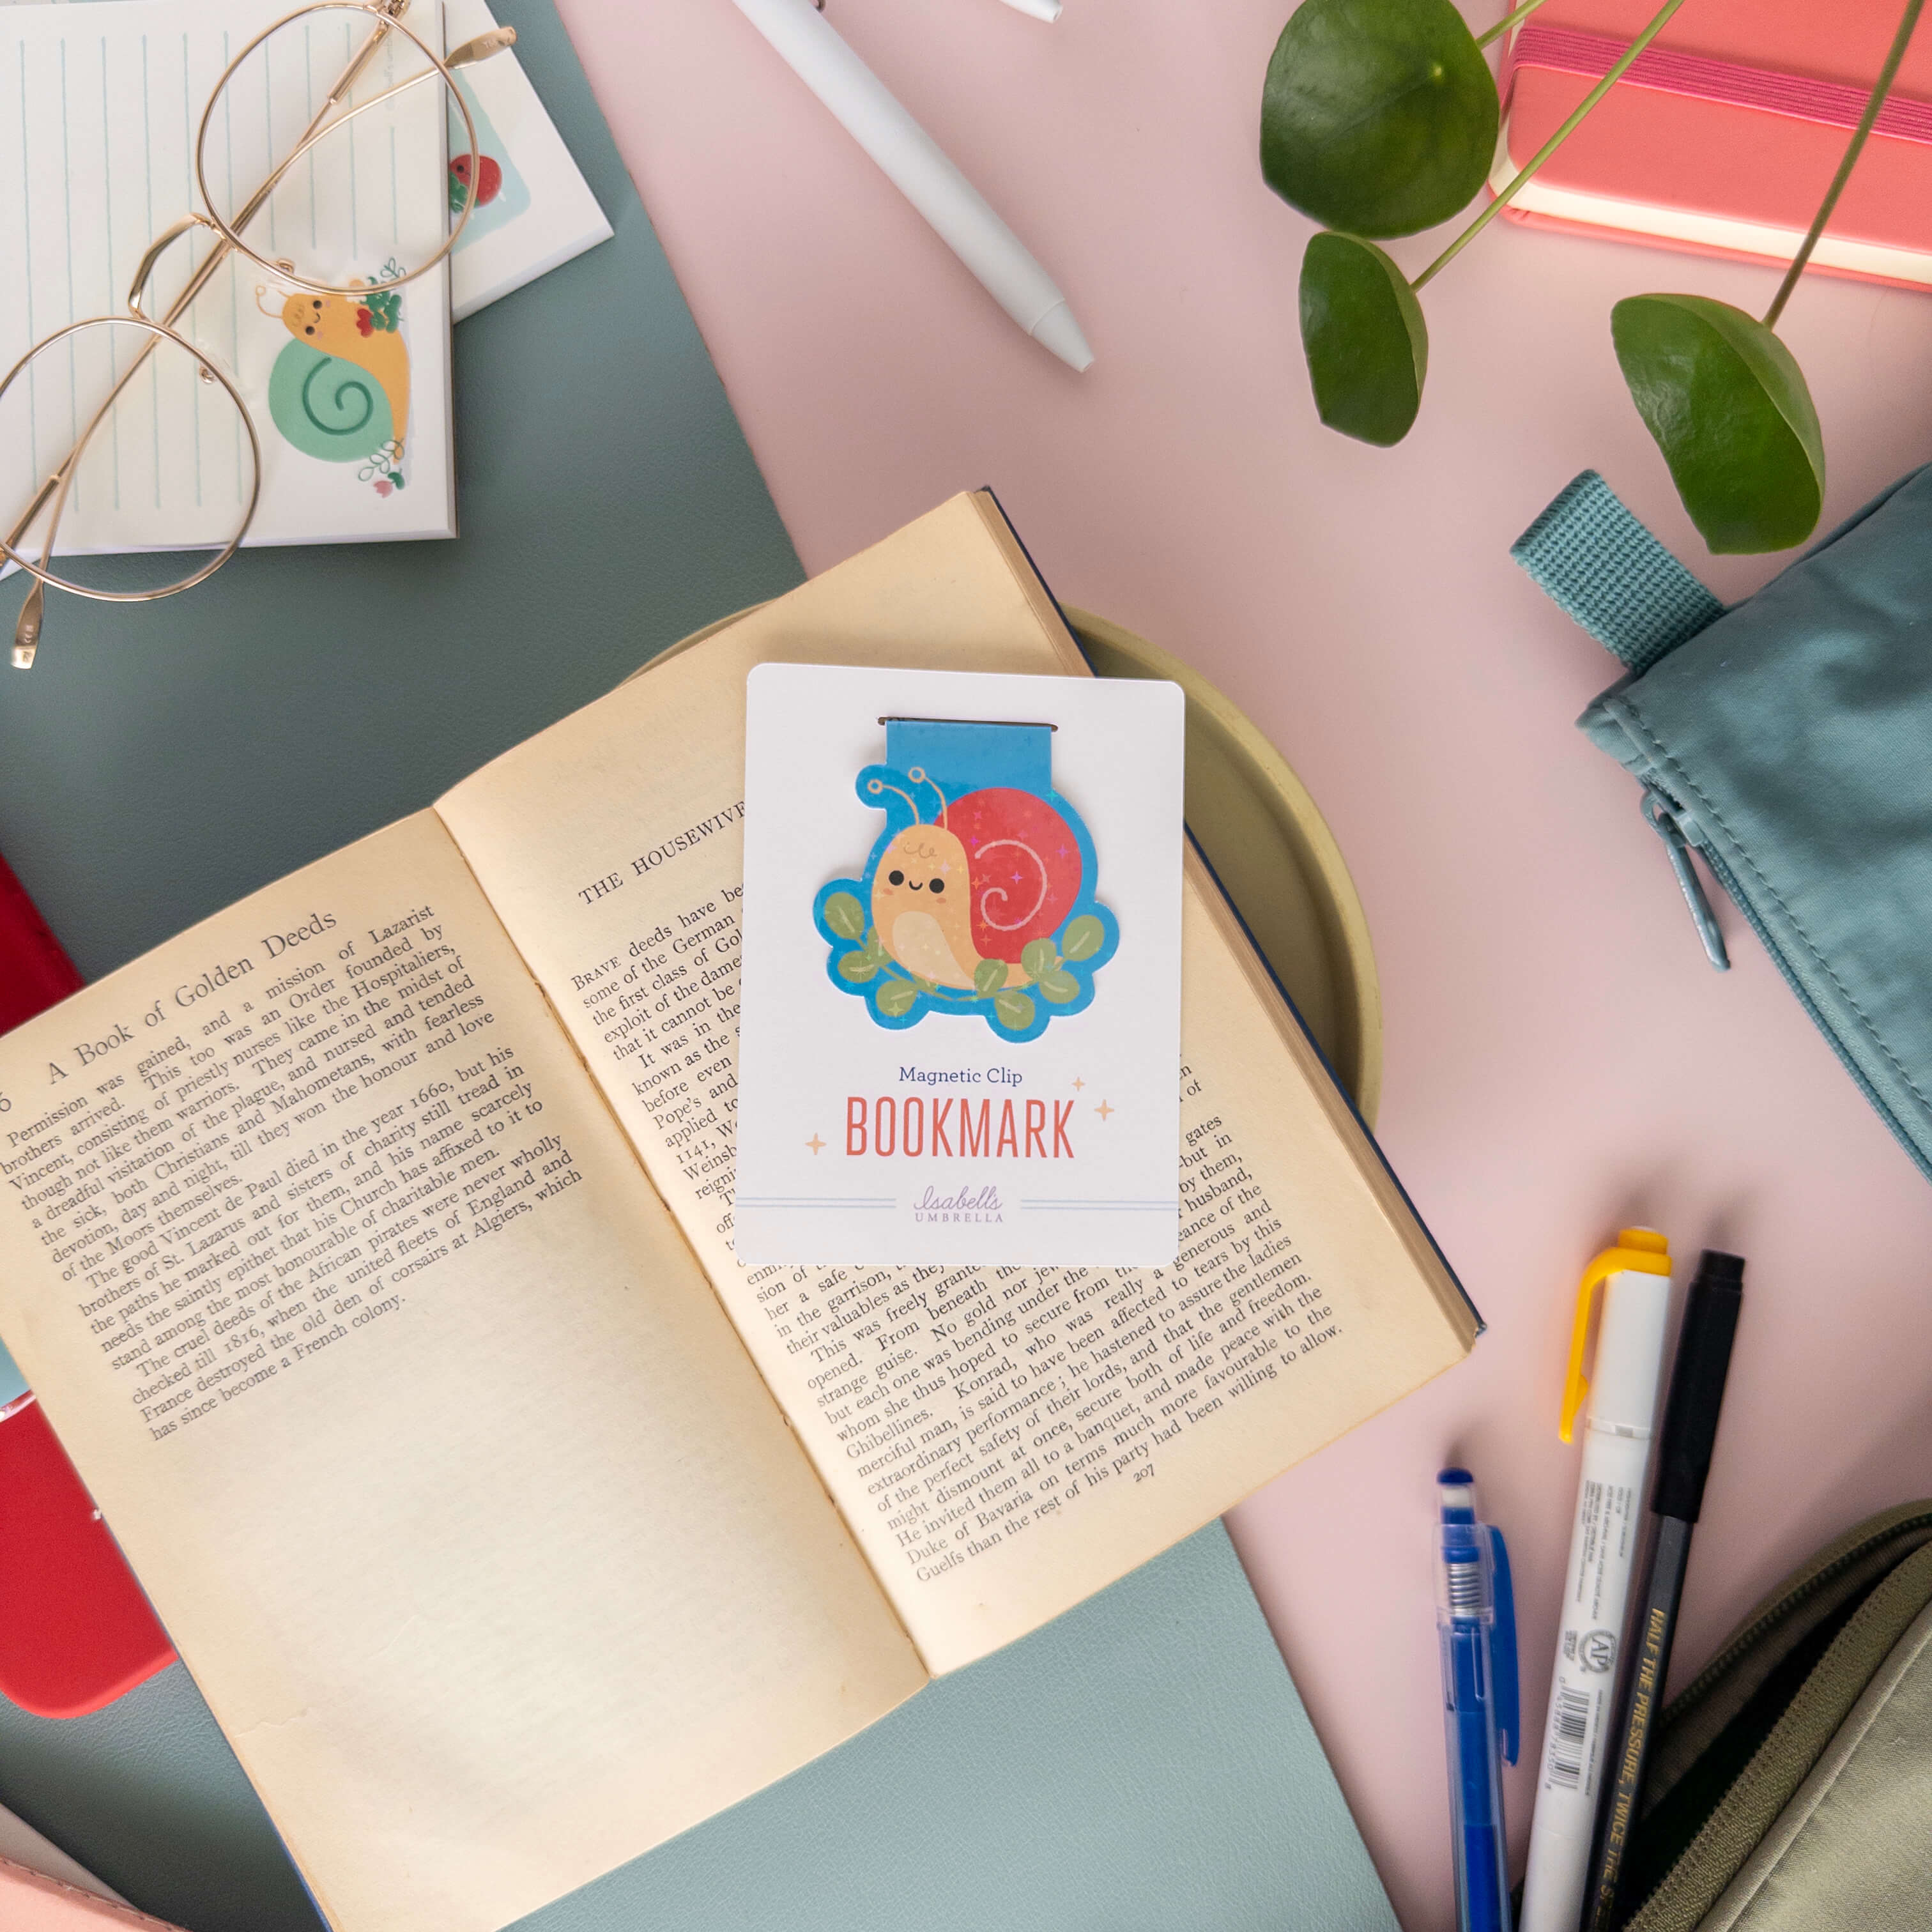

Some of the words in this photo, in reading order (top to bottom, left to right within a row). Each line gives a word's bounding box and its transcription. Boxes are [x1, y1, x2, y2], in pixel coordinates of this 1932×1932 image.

[577, 871, 624, 905] THE
[582, 981, 621, 1009] some
[622, 963, 640, 985] of
[640, 953, 668, 974] the
[671, 914, 737, 955] German
[628, 926, 673, 958] deeds
[676, 901, 717, 930] have
[48, 1061, 70, 1085] A
[72, 1023, 136, 1067] Book
[144, 999, 167, 1028] of
[174, 958, 256, 1008] Golden
[259, 912, 337, 960] Deeds
[592, 1006, 617, 1027] the
[618, 985, 650, 1011] first
[651, 964, 689, 992] class
[693, 946, 710, 967] of
[603, 1007, 653, 1044] exploit
[654, 992, 672, 1013] of
[672, 981, 701, 1002] the
[0, 1134, 63, 1176] brothers
[69, 1096, 126, 1137] arrived.
[142, 1065, 182, 1091] This
[188, 1046, 216, 1067] too
[222, 1025, 253, 1046] was
[260, 1008, 282, 1026] an
[288, 977, 336, 1009] Order
[345, 936, 415, 980] founded
[418, 924, 443, 942] by
[5, 1096, 89, 1149] Permission
[95, 1074, 126, 1095] was
[136, 1035, 192, 1078] gained,
[201, 1009, 233, 1036] and
[242, 1001, 255, 1013] a
[264, 962, 327, 1000] mission
[337, 940, 356, 961] of
[367, 905, 436, 946] Lazarist
[612, 1037, 644, 1061] that
[641, 1027, 659, 1043] it
[661, 996, 713, 1033] cannot
[710, 984, 736, 1002] be
[636, 1052, 657, 1070] It
[659, 1034, 690, 1056] was
[691, 1022, 713, 1038] in
[716, 1003, 742, 1023] the
[7, 1153, 75, 1191] Vincent,
[76, 1108, 150, 1156] consisting
[153, 1090, 171, 1111] of
[174, 1061, 229, 1103] priestly
[231, 1032, 282, 1067] nurses
[283, 1013, 318, 1036] like
[321, 995, 351, 1015] the
[349, 944, 456, 1000] Hospitaliers,
[631, 1062, 684, 1097] known
[684, 1050, 703, 1067] as
[703, 1034, 731, 1055] the
[640, 1081, 690, 1114] before
[696, 1057, 733, 1083] even
[898, 1066, 981, 1086] Magnetic
[986, 1068, 1023, 1087] Clip
[40, 1227, 67, 1246] the
[72, 1204, 108, 1229] sick,
[110, 1177, 150, 1205] both
[154, 1132, 231, 1180] Christians
[236, 1108, 267, 1135] and
[268, 1053, 376, 1115] Mahometans,
[380, 1027, 419, 1053] with
[424, 994, 485, 1032] fearless
[652, 1096, 703, 1131] Pope's
[708, 1072, 740, 1100] and
[846, 1096, 1075, 1158] BOOKMARK
[1184, 1116, 1223, 1148] gates
[84, 1266, 120, 1289] The
[121, 1239, 160, 1275] good
[158, 1207, 223, 1245] Vincent
[224, 1195, 245, 1213] de
[244, 1169, 283, 1200] Paul
[286, 1148, 321, 1177] died
[319, 1142, 341, 1158] in
[341, 1125, 369, 1146] the
[369, 1104, 405, 1135] year
[409, 1082, 455, 1109] 1660,
[454, 1061, 487, 1083] but
[486, 1046, 515, 1068] his
[913, 1185, 1003, 1211] Isabell's
[1199, 1153, 1243, 1181] them,
[914, 1213, 1004, 1223] UMBRELLA
[111, 1338, 153, 1370] stand
[153, 1311, 207, 1347] among
[206, 1296, 233, 1316] the
[234, 1273, 273, 1301] most
[272, 1225, 359, 1278] honourable
[361, 1208, 378, 1229] of
[381, 1170, 458, 1218] charitable
[459, 1149, 501, 1175] men.
[774, 1323, 793, 1338] in
[796, 1307, 822, 1327] the
[827, 1270, 893, 1315] garrison,
[809, 1338, 848, 1363] This
[852, 1319, 882, 1342] was
[885, 1291, 928, 1324] freely
[148, 1420, 179, 1442] has
[180, 1397, 218, 1425] since
[217, 1364, 279, 1402] become
[280, 1356, 293, 1369] a
[291, 1323, 349, 1361] French
[351, 1294, 406, 1328] colony.
[816, 1374, 869, 1407] strange
[875, 1348, 919, 1381] guise.
[929, 1322, 958, 1344] No
[963, 1294, 998, 1328] gold
[1001, 1277, 1029, 1301] nor
[895, 1529, 922, 1548] He
[921, 1495, 977, 1535] invited
[977, 1475, 1018, 1504] them
[1020, 1457, 1041, 1480] all
[1042, 1450, 1061, 1466] to
[1062, 1441, 1075, 1454] a
[1073, 1401, 1141, 1445] banquet,
[1142, 1377, 1173, 1405] and
[1173, 1354, 1215, 1386] made
[1219, 1325, 1261, 1361] peace
[1262, 1302, 1296, 1328] with
[1296, 1287, 1323, 1308] the
[916, 1550, 965, 1581] Guelfs
[966, 1532, 1003, 1558] than
[1004, 1515, 1031, 1536] the
[1032, 1494, 1062, 1520] rest
[1064, 1478, 1082, 1499] of
[1083, 1466, 1110, 1487] his
[1111, 1441, 1149, 1476] party
[1150, 1418, 1183, 1446] had
[1184, 1397, 1225, 1425] been
[1227, 1362, 1278, 1399] willing
[1279, 1350, 1298, 1366] to
[1299, 1324, 1343, 1354] allow.
[1133, 1462, 1155, 1483] 207
[1590, 1634, 1610, 1667] AP
[1645, 1607, 1666, 1656] HALF
[1637, 1657, 1657, 1693] THE
[1618, 1691, 1650, 1786] PRESSURE,
[1609, 1791, 1632, 1846] TWICE
[1602, 1848, 1621, 1883] THE
